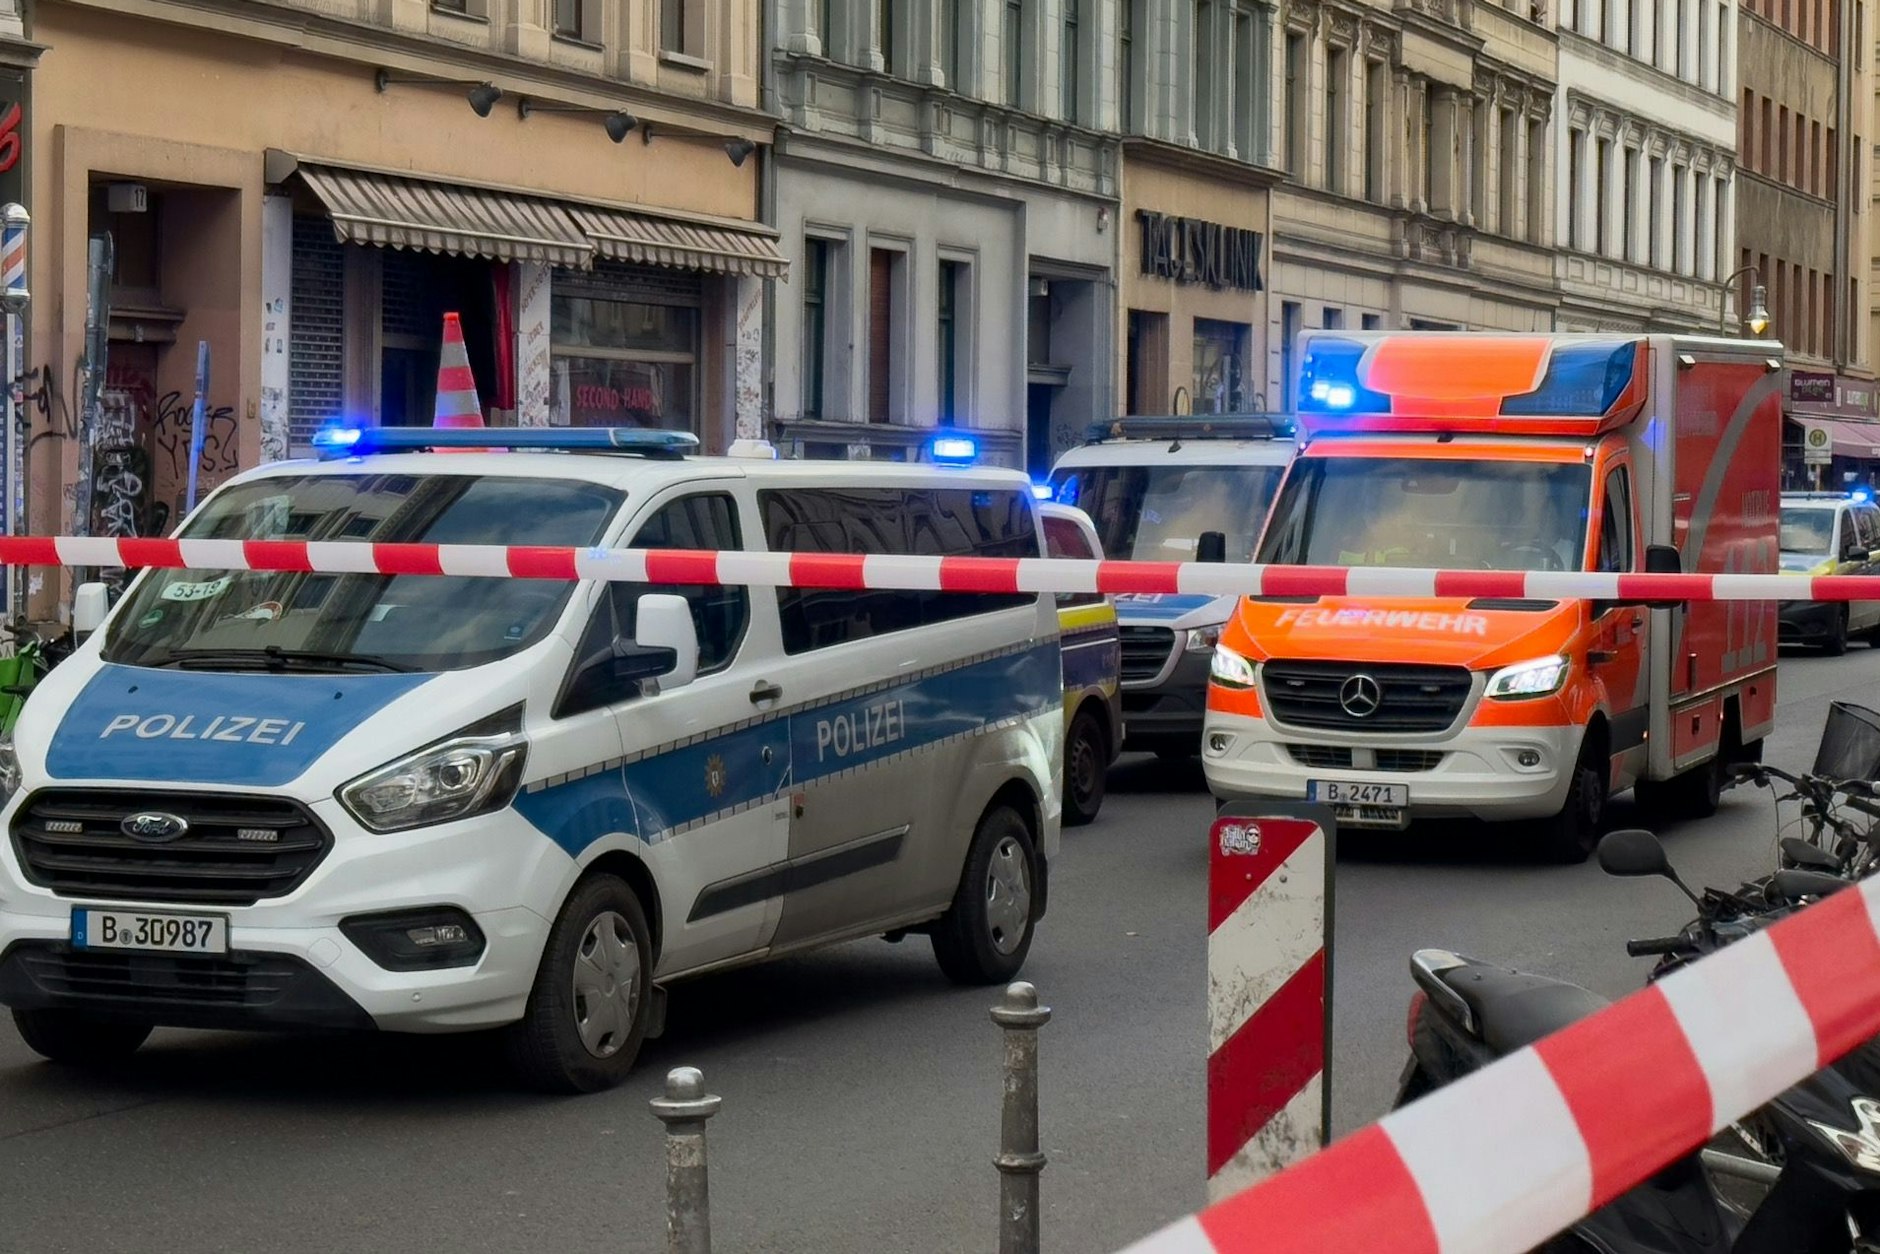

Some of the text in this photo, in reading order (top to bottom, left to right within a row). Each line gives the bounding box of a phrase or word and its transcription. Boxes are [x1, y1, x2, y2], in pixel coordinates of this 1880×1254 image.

[134, 187, 146, 208] 17
[1134, 208, 1264, 292] TAGESKLINIK
[575, 385, 619, 410] SECOND
[1274, 609, 1488, 636] FEUERWEHR
[100, 714, 306, 746] POLIZEI
[817, 699, 906, 763] POLIZEI
[1328, 783, 1393, 803] B 2471
[131, 815, 171, 835] Ford
[102, 915, 213, 948] B 30987
